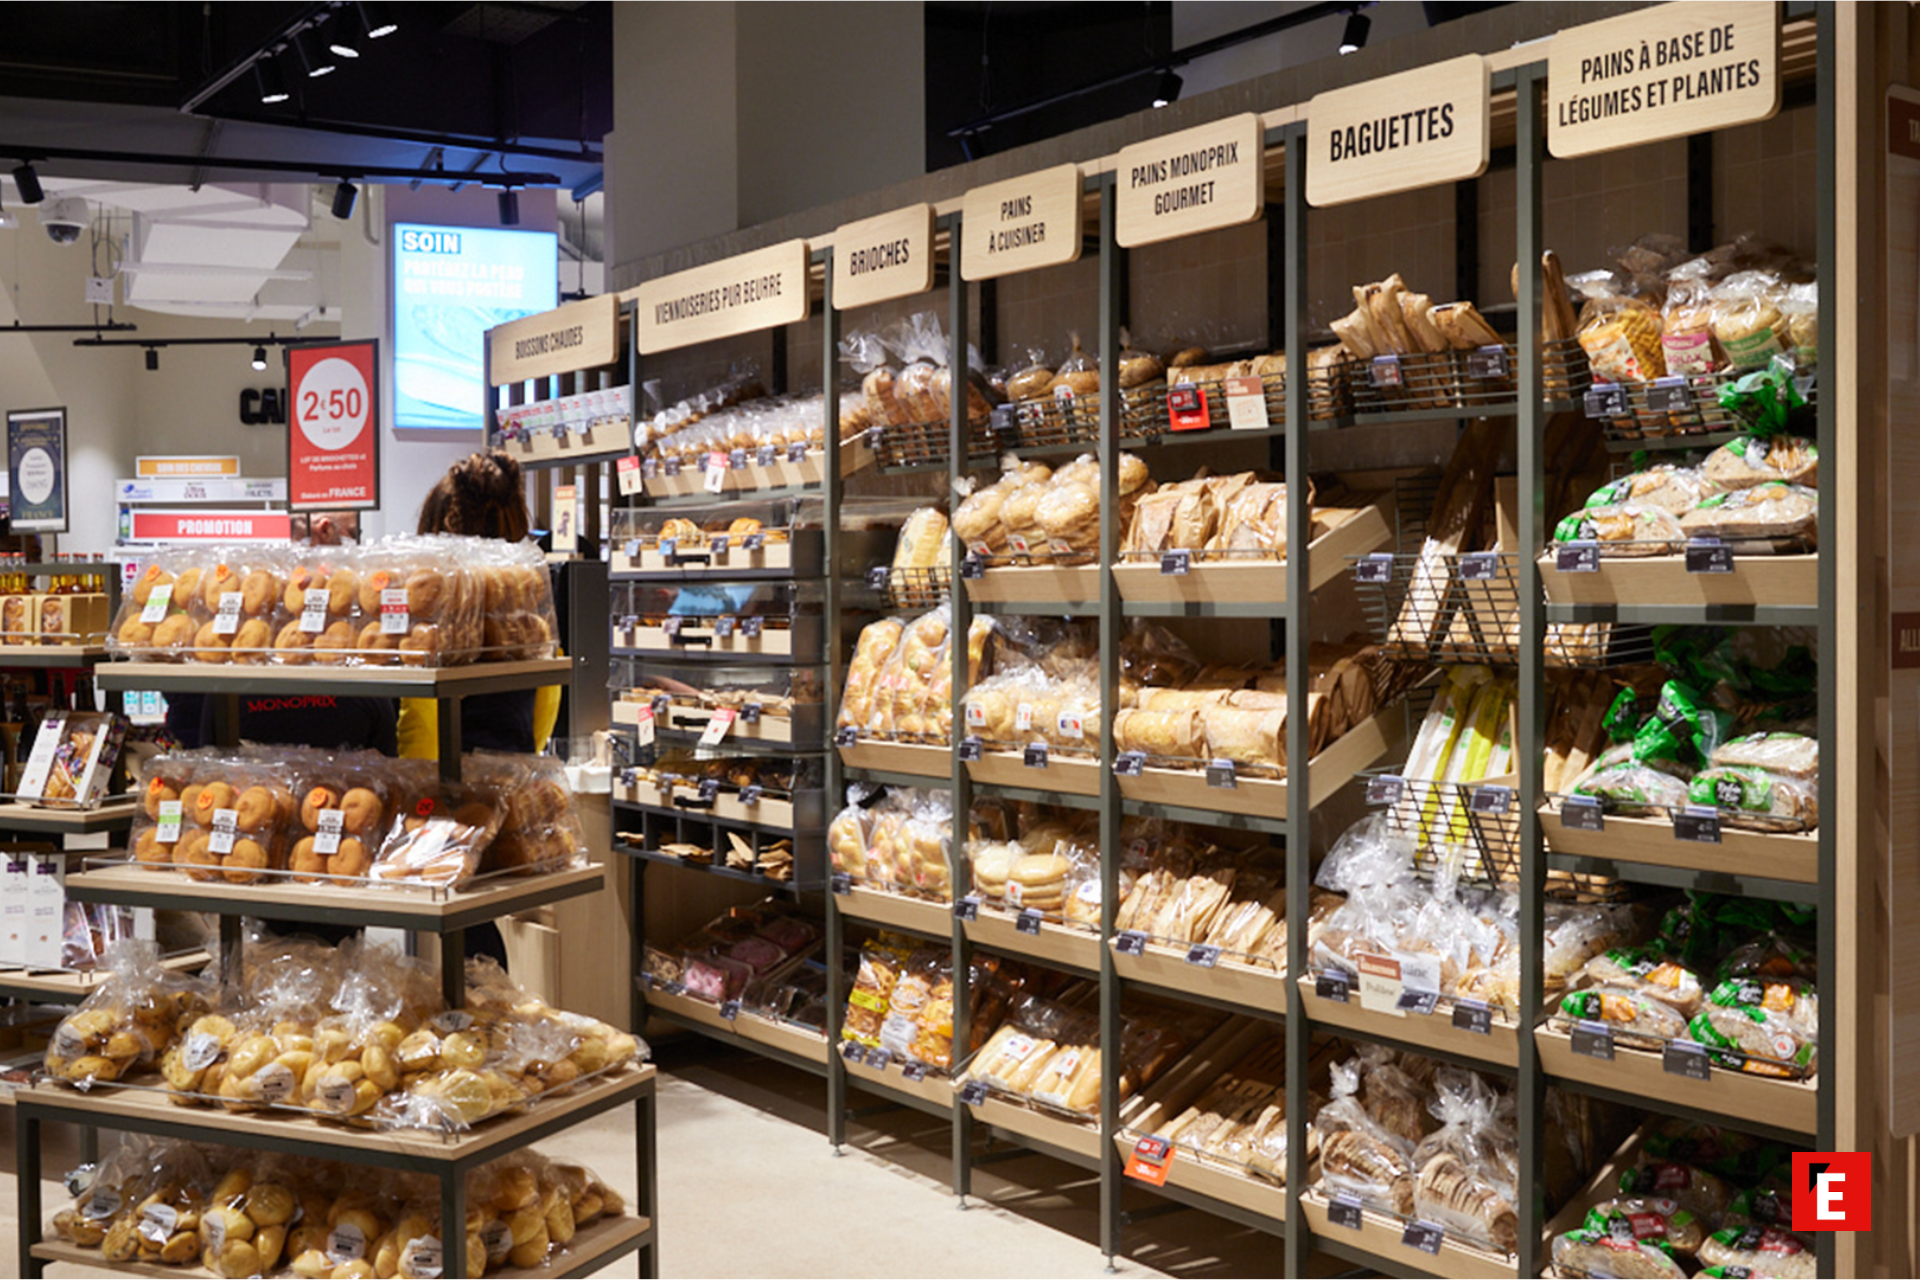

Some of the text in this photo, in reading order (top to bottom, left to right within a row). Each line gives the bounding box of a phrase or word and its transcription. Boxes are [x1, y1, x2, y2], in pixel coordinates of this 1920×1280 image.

[1581, 24, 1734, 84] PAINS À BASE DE
[1559, 59, 1760, 127] LÉGUMES ET PLANTES
[1330, 103, 1454, 162] BAGUETTES
[1132, 141, 1238, 189] PAINS MONOPRIX
[1001, 195, 1032, 221] PAINS
[1155, 181, 1215, 215] GOURMET
[404, 232, 458, 253] SOIN
[988, 222, 1045, 254] À CUISINER
[471, 264, 488, 279] LA
[490, 265, 524, 281] PEAU
[850, 238, 909, 276] BRIOCHES
[403, 278, 427, 294] QUI
[429, 279, 463, 296] VOUS
[655, 273, 781, 325] VIENNOISERIES PUR BEURRE
[516, 325, 583, 359] BOISSONS CHAUDES
[329, 486, 366, 498] FRANCE
[177, 519, 253, 535] PROMOTION
[247, 695, 337, 713] MONOPRIX
